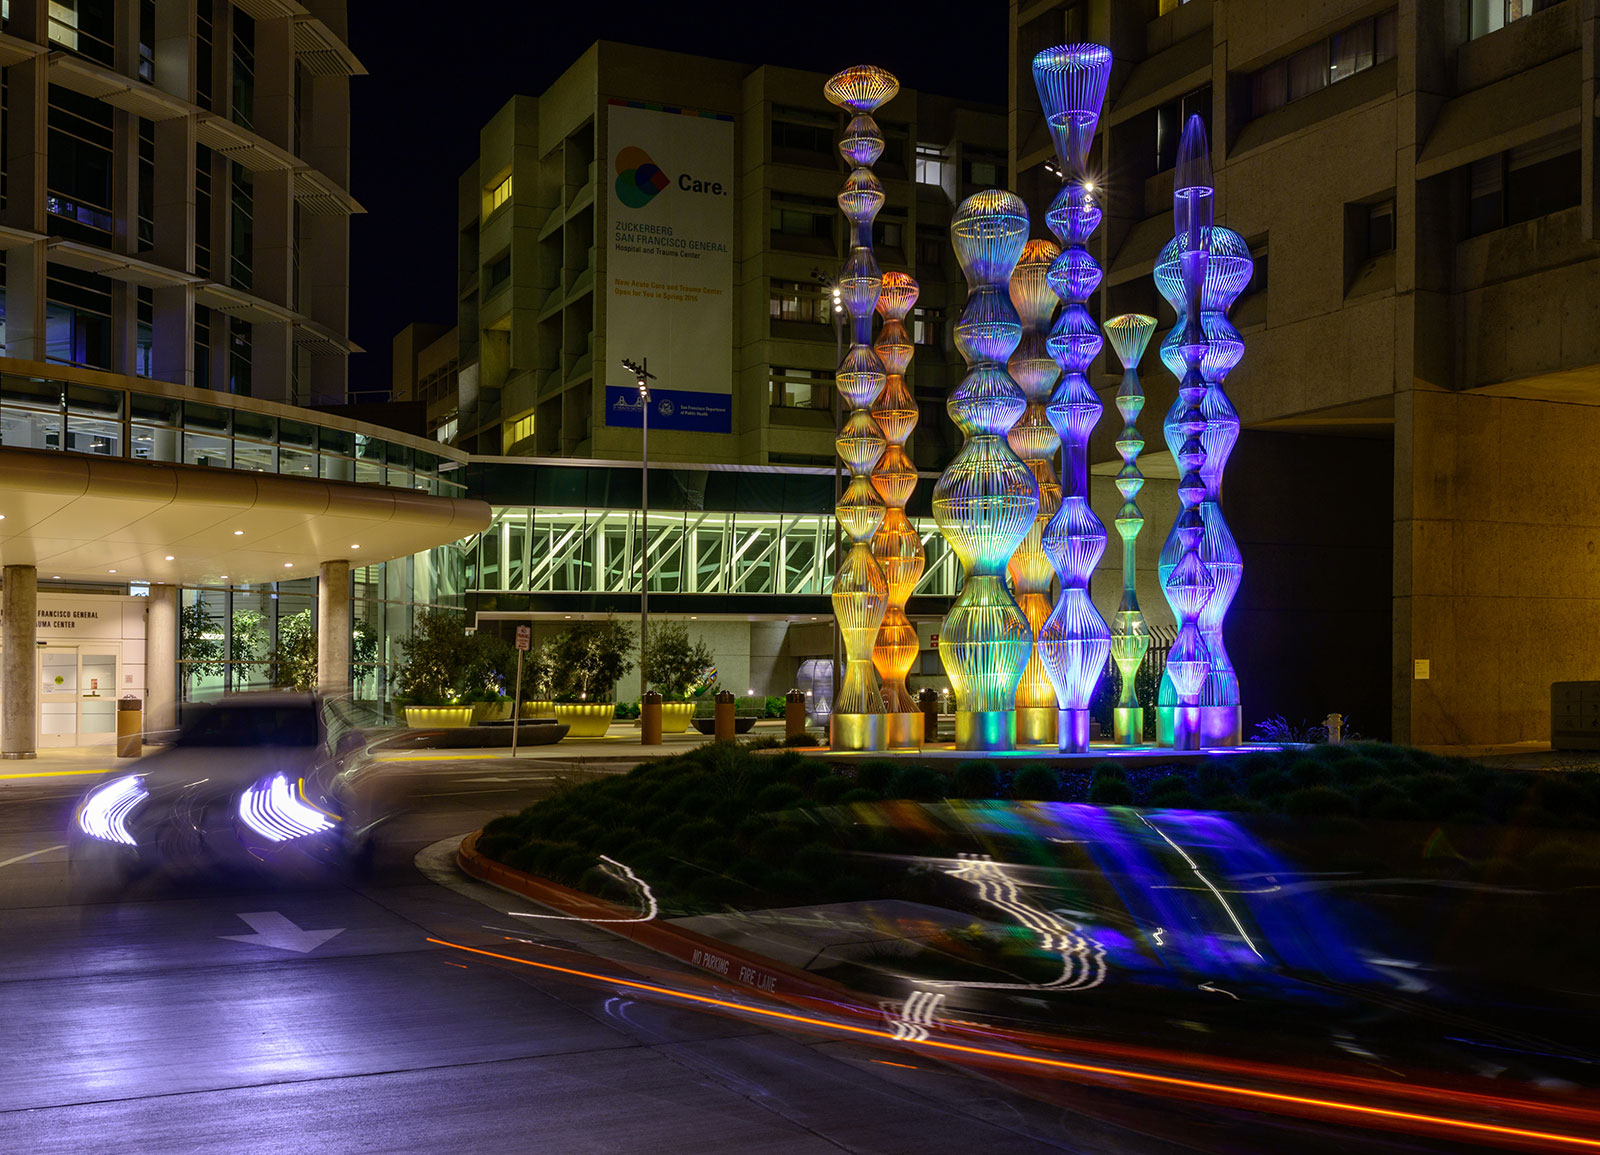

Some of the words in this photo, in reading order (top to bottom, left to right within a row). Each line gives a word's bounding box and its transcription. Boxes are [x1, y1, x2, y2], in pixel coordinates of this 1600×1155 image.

[678, 174, 728, 196] Care.
[616, 221, 672, 236] ZUCKERBERG
[615, 233, 634, 242] SAN
[637, 235, 686, 248] FRANCISCO
[689, 240, 728, 253] GENERAL
[616, 244, 642, 253] Hospital
[656, 248, 678, 257] Trauma
[680, 250, 700, 259] Center
[615, 288, 630, 296] Open
[664, 293, 684, 302] Spring
[651, 282, 665, 290] Care
[680, 285, 702, 293] Trauma
[703, 287, 722, 295] Center
[37, 610, 71, 619] FRANCISCO
[73, 611, 98, 619] GENERAL
[692, 949, 702, 965] NO
[702, 952, 730, 975] PARKING
[739, 966, 756, 986] FIRE
[757, 972, 777, 994] LANE
